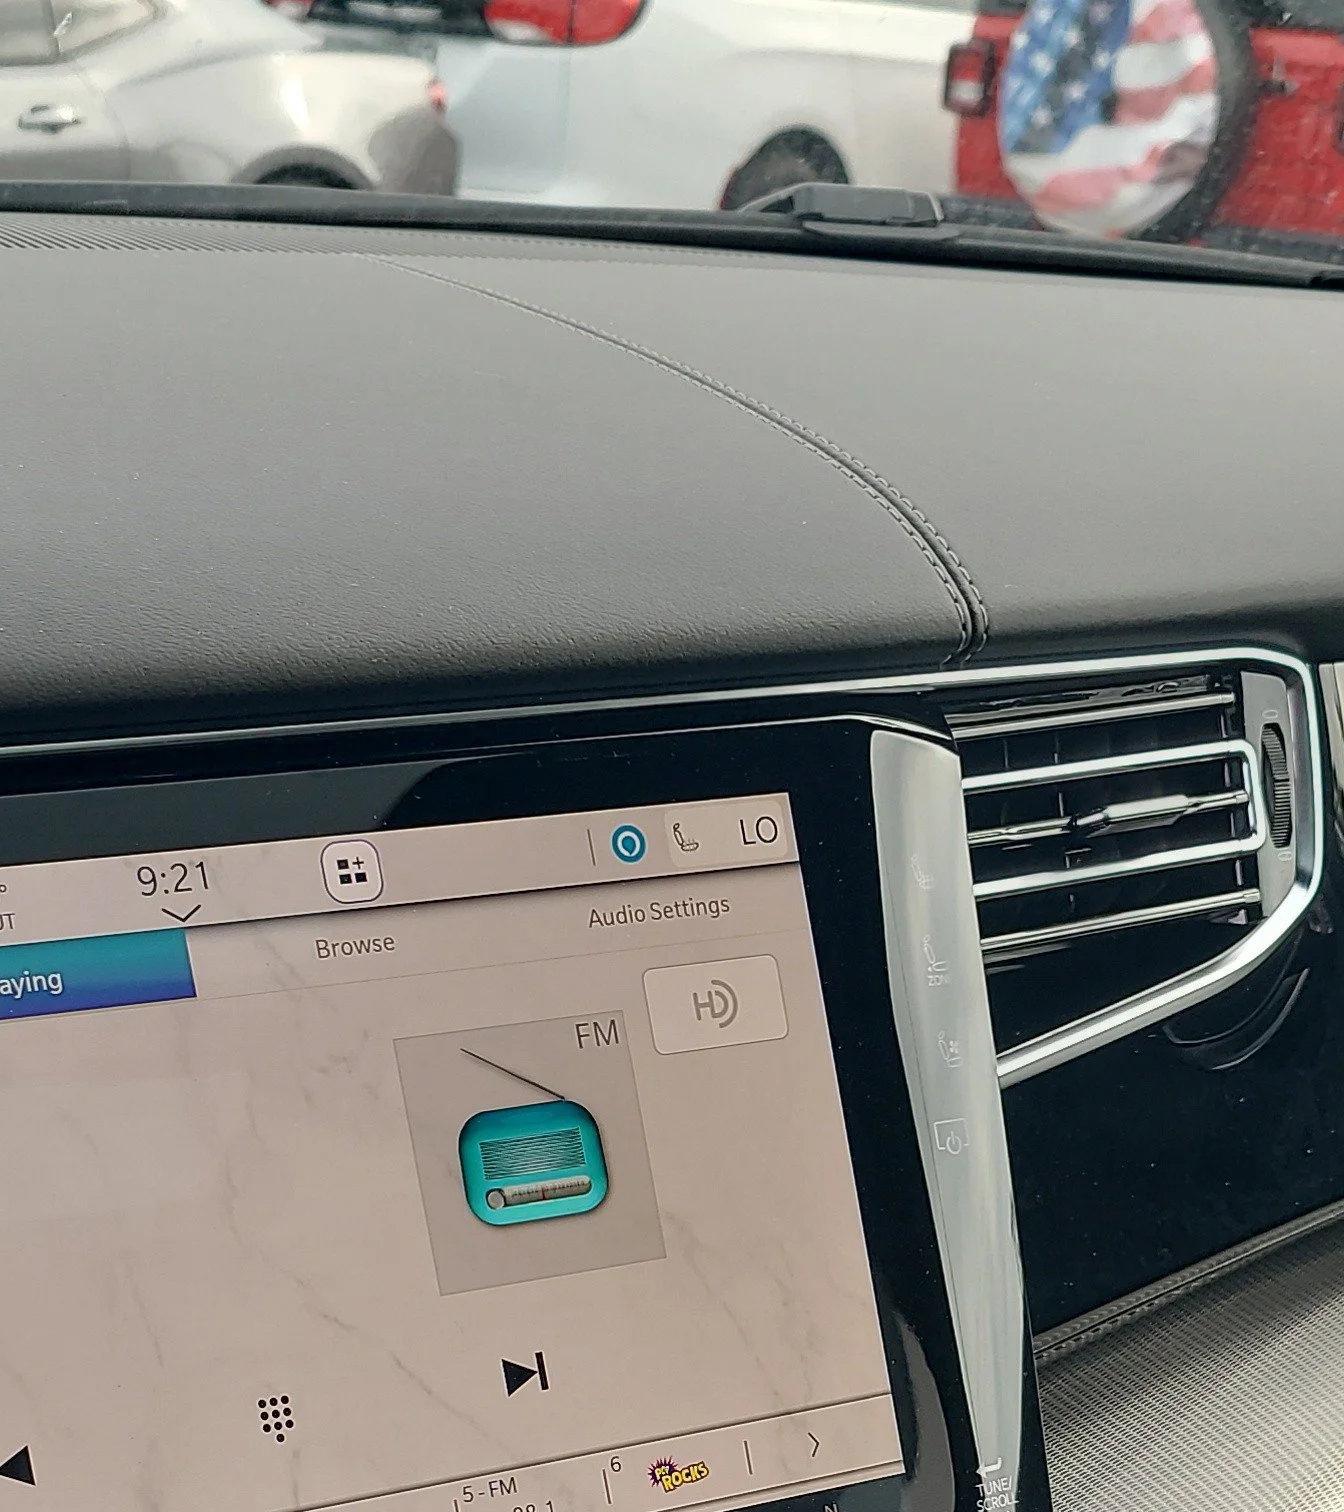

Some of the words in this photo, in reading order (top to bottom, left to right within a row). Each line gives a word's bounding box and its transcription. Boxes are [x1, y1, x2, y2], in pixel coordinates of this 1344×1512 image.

[739, 815, 778, 847] LO
[136, 860, 211, 898] 9:21
[588, 904, 646, 929] Audio
[651, 895, 730, 926] Settings
[316, 932, 396, 960] Browse
[575, 1019, 621, 1050] FM
[610, 1457, 621, 1474] 6
[661, 1462, 709, 1491] ROCKS
[975, 1475, 1012, 1497] TUNE/
[976, 1493, 1019, 1512] SCROLL
